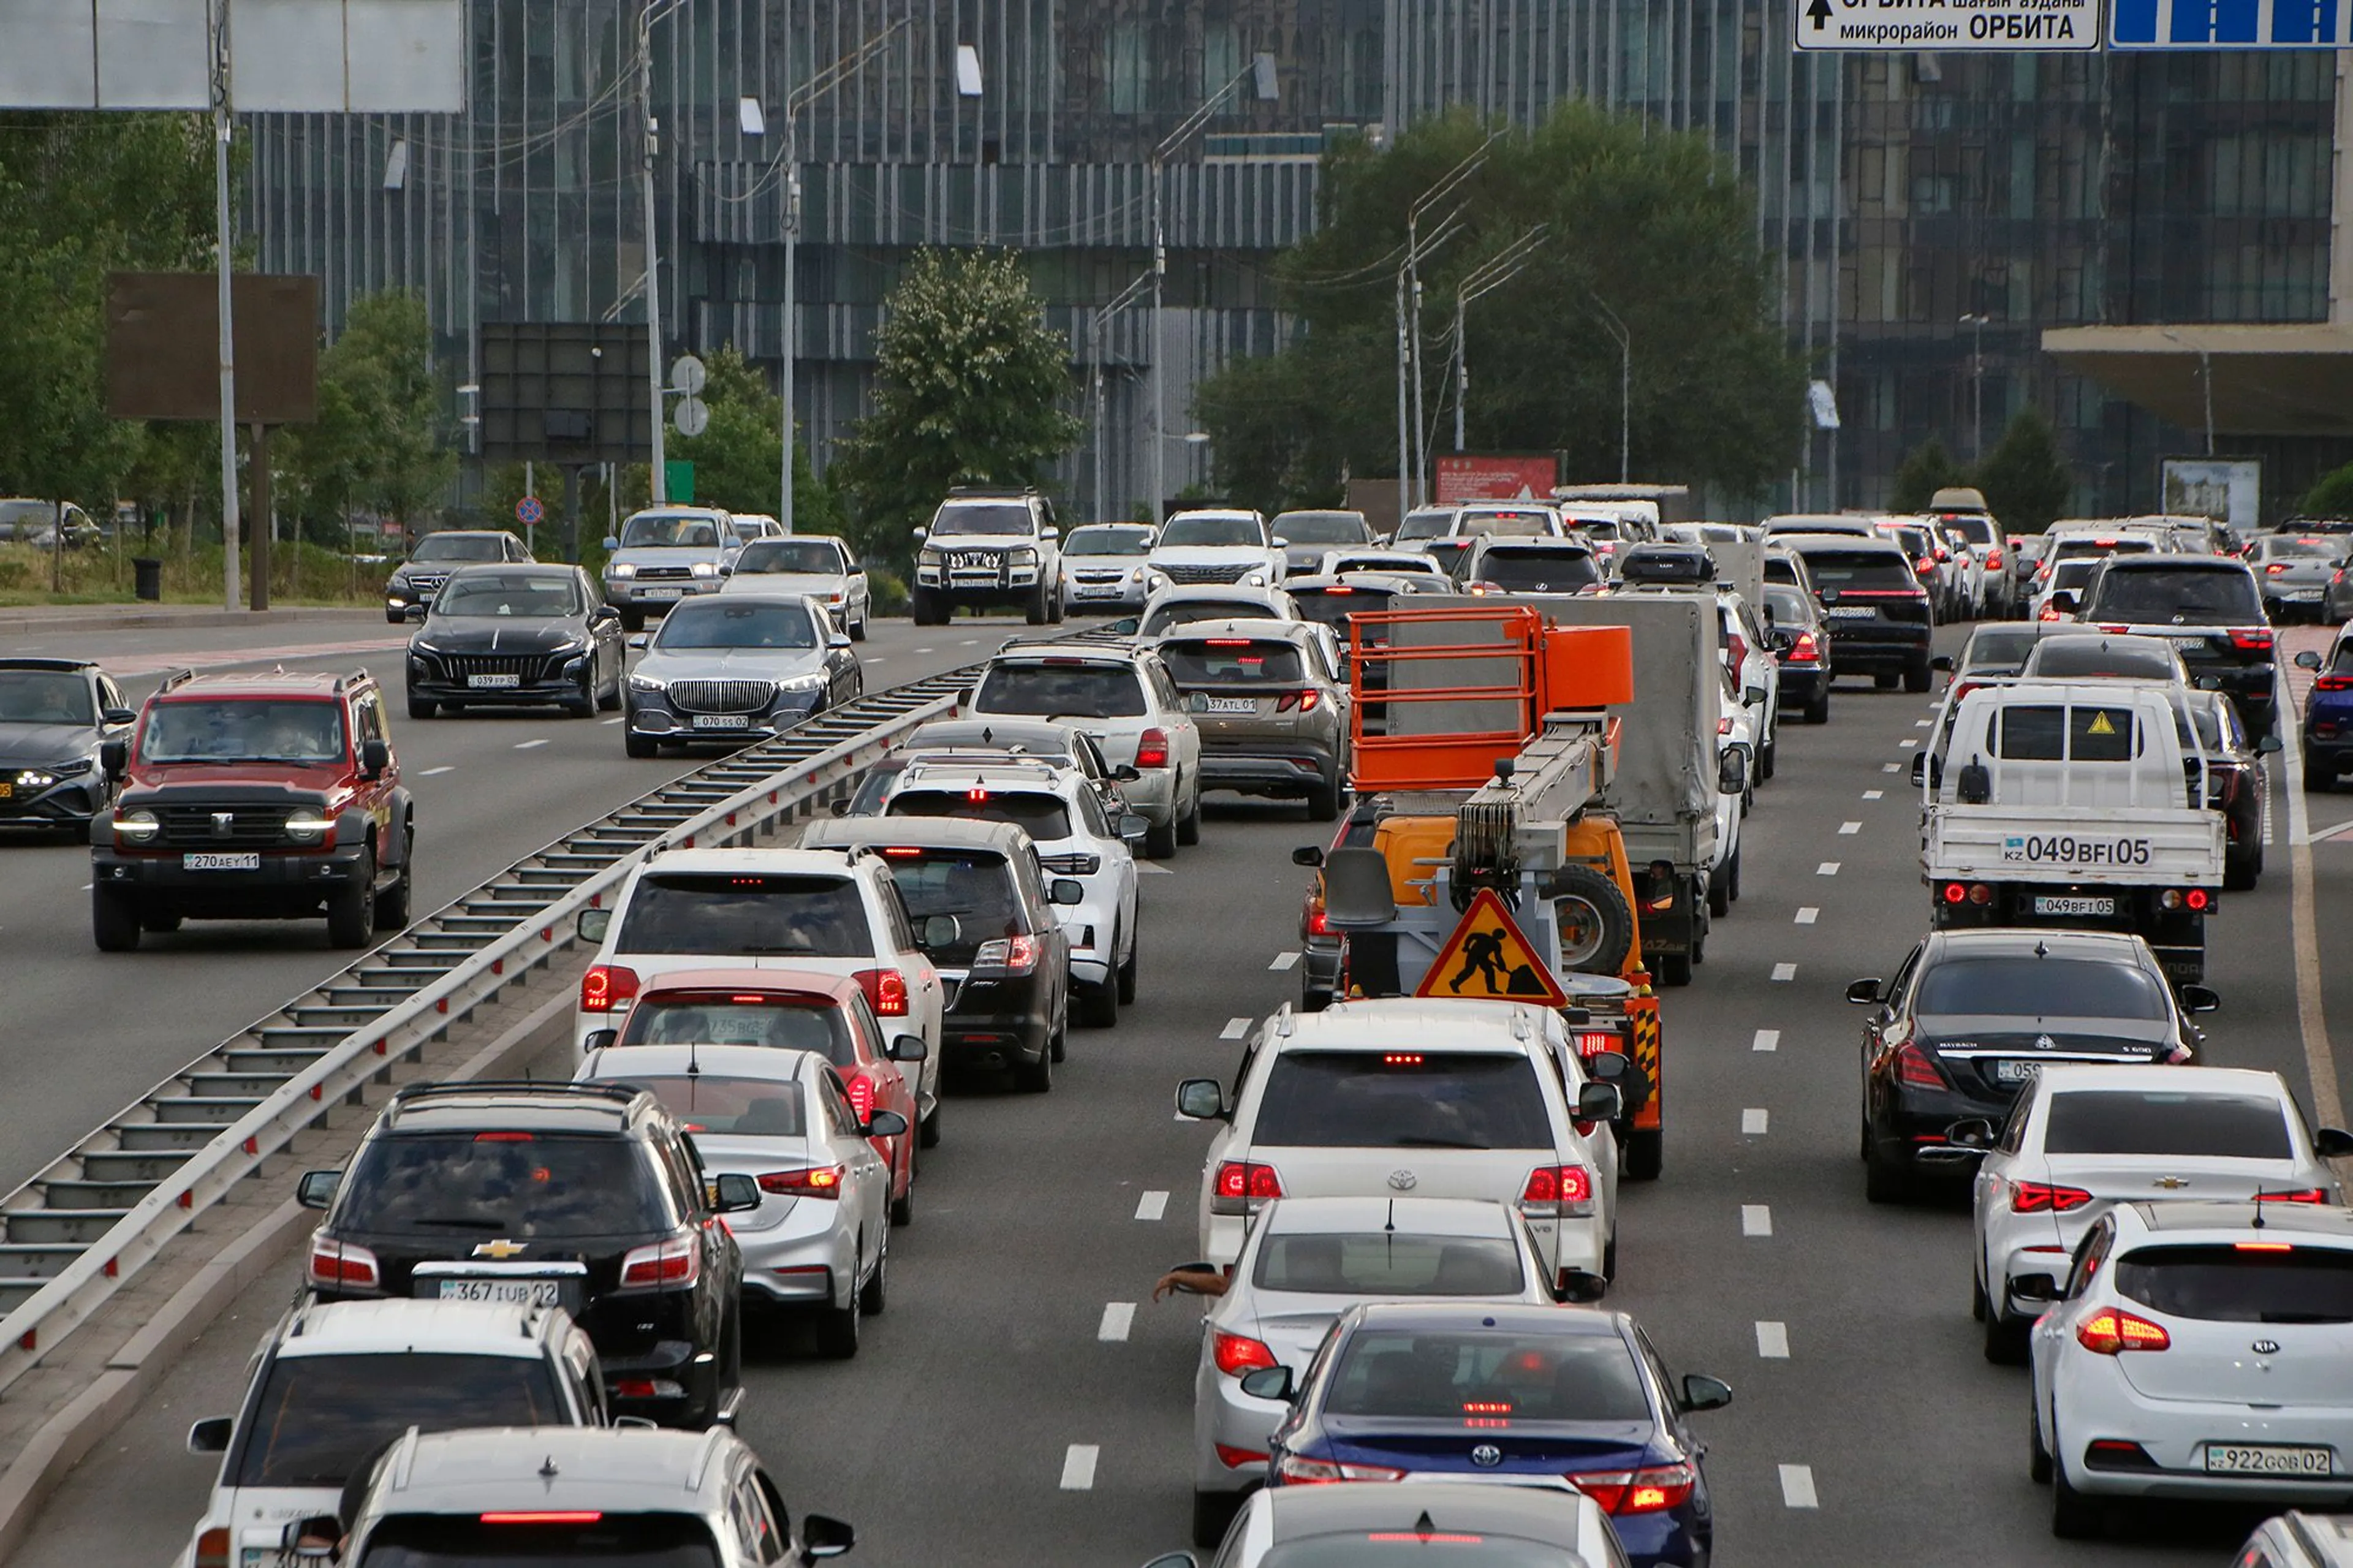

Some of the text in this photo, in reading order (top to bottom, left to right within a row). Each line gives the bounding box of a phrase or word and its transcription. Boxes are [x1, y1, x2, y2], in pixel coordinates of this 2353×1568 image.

[1840, 14, 2074, 44] микрорайон ОРБИТА
[477, 676, 493, 684] 039
[703, 717, 720, 725] 070
[2004, 851, 2023, 861] KZ
